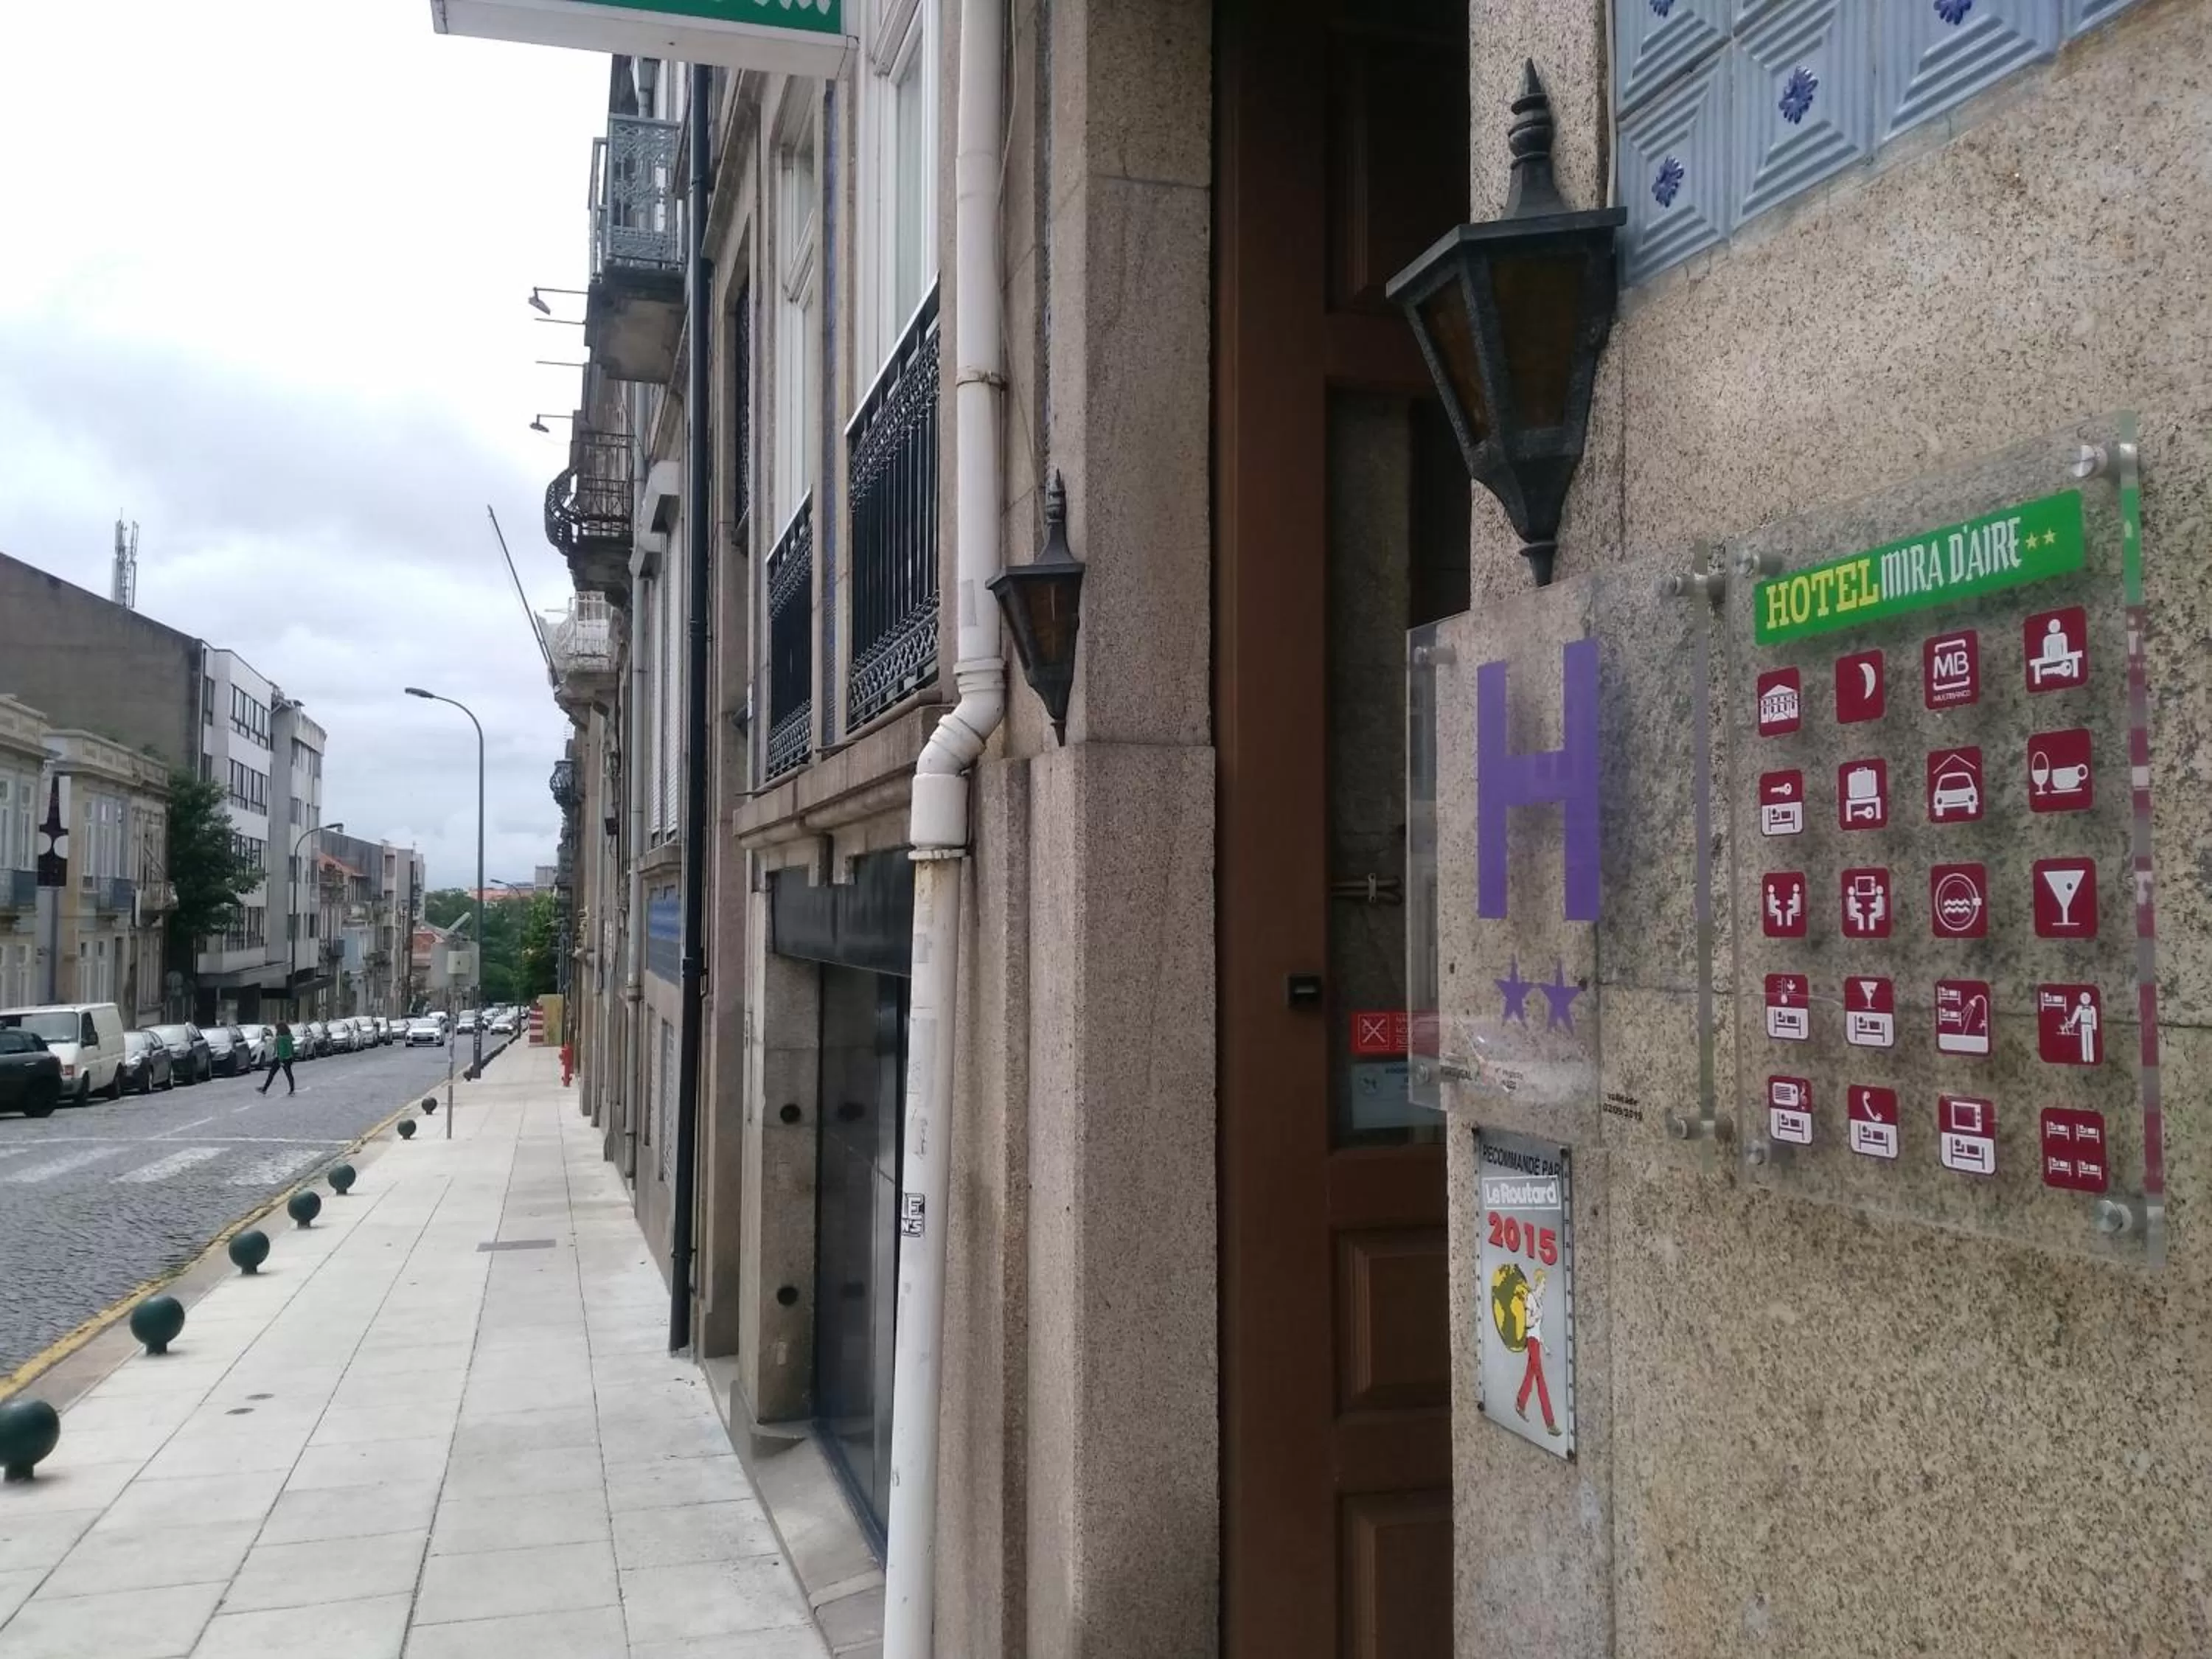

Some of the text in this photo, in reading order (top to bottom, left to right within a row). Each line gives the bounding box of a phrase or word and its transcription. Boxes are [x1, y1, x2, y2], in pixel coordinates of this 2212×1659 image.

[1766, 517, 2023, 630] HOTEL MIRA D'AIRE
[1933, 650, 1969, 680] MB
[1478, 636, 1600, 921] H
[1487, 1211, 1558, 1266] 2015
